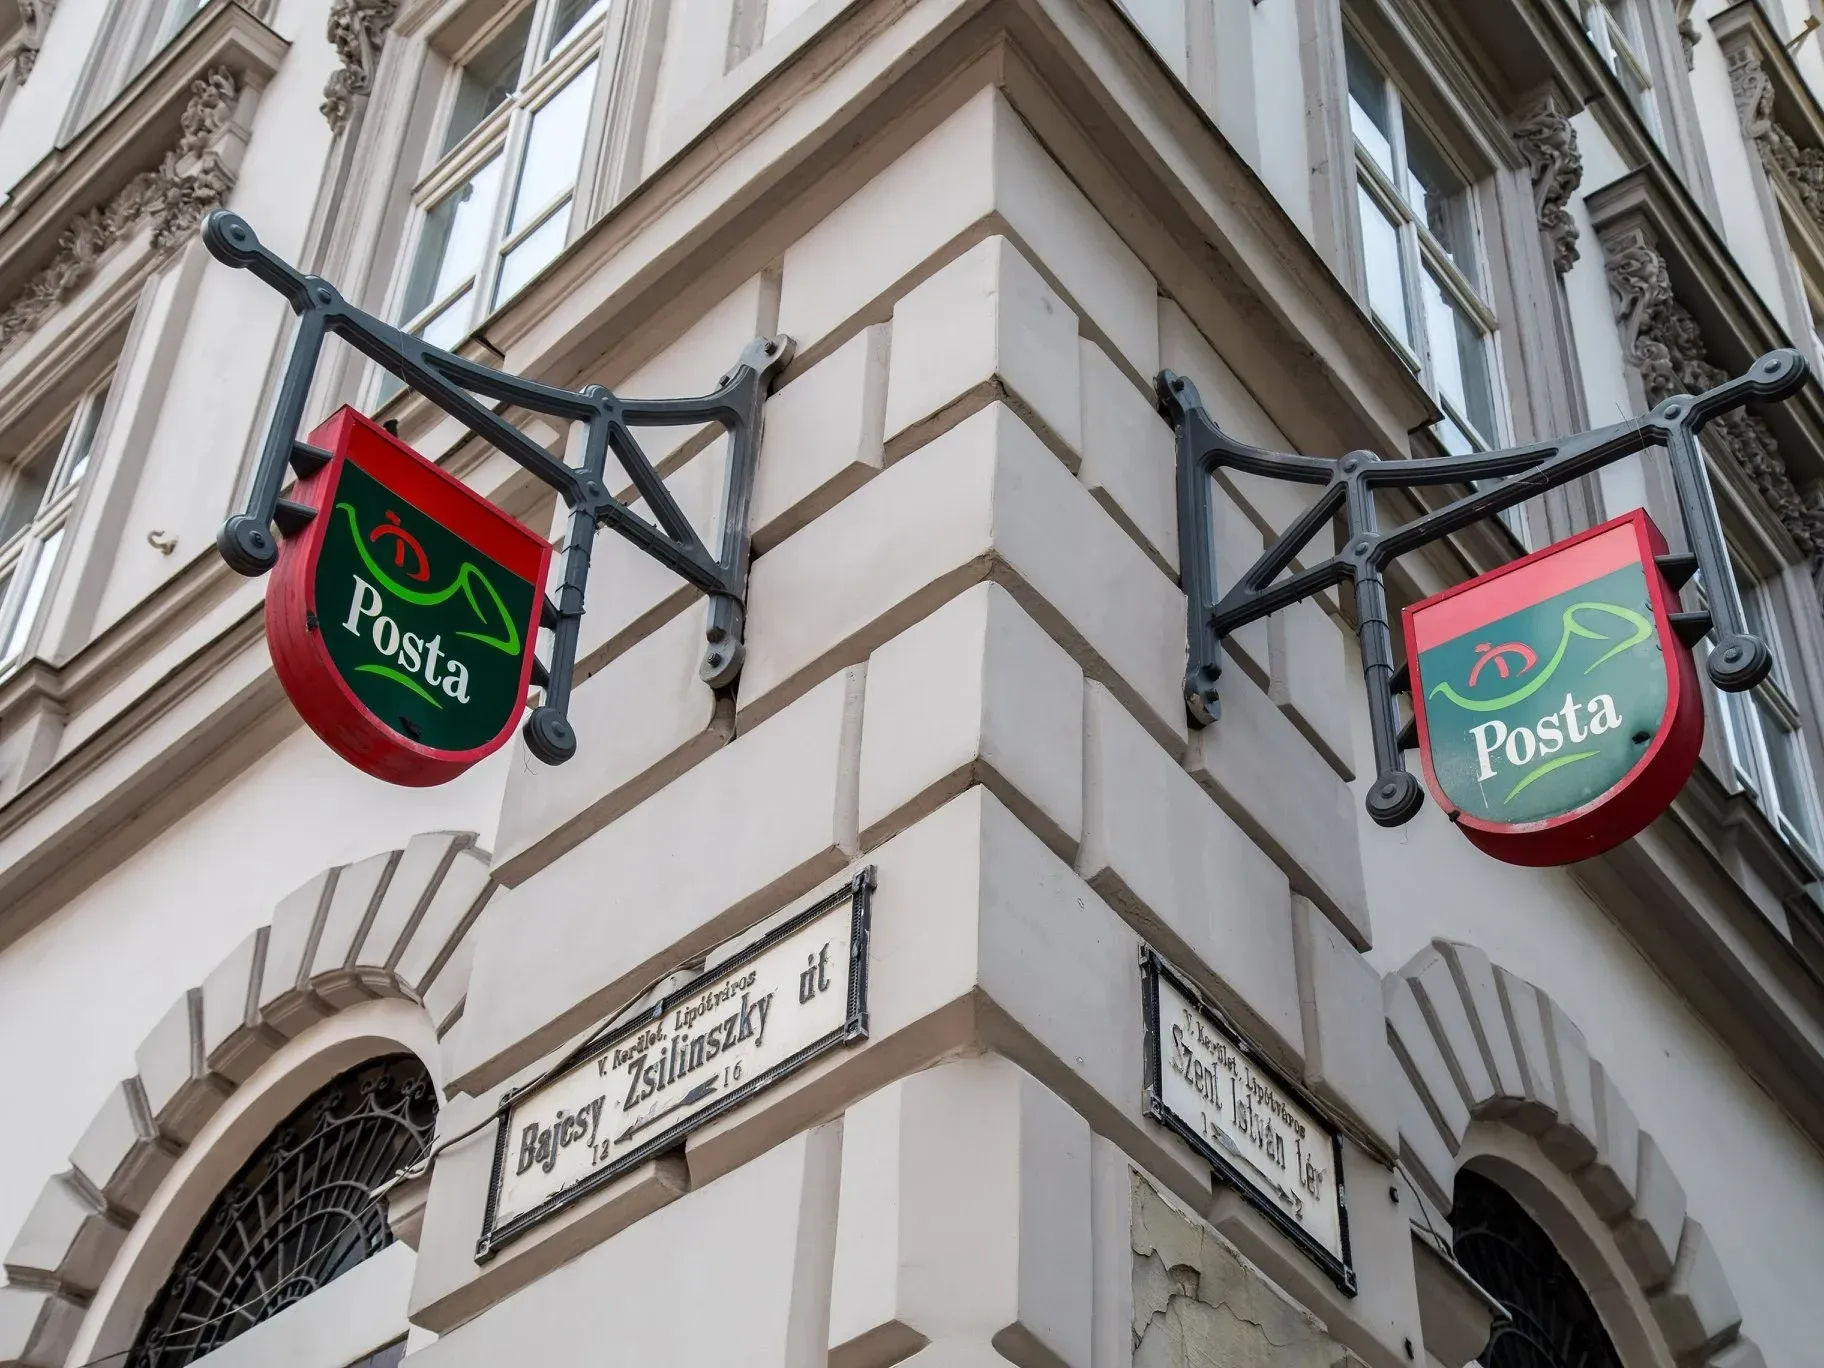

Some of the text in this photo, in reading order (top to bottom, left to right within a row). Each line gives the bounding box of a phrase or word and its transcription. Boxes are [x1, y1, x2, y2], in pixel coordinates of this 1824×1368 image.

[342, 574, 470, 704] Posta
[1469, 692, 1622, 783] Posta
[516, 942, 831, 1176] Bajcsy Zsilinszky út
[597, 1056, 608, 1077] V.
[674, 970, 756, 1031] Lipótváros
[1183, 1008, 1195, 1035] V.
[1245, 1066, 1306, 1140] Lipótváros
[592, 1060, 743, 1166] 12 16
[1169, 1023, 1223, 1111] Szent
[1230, 1077, 1287, 1171] István
